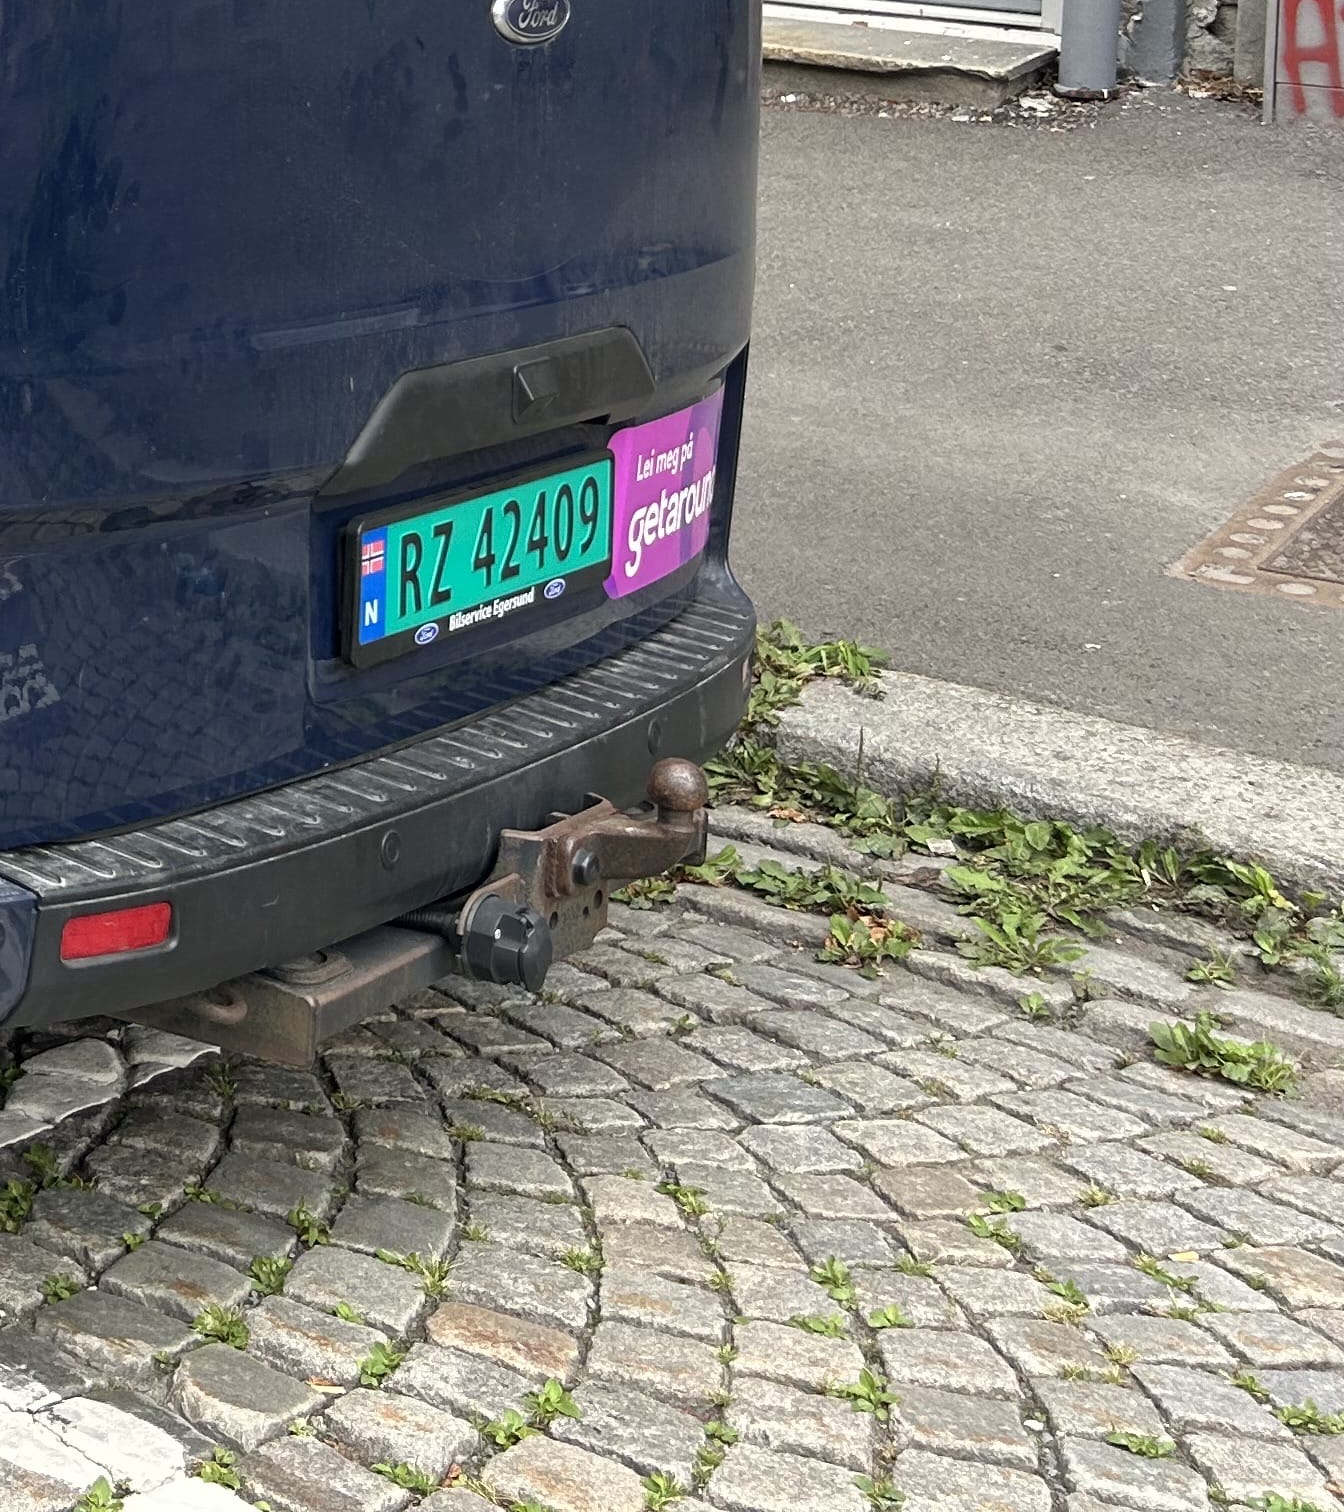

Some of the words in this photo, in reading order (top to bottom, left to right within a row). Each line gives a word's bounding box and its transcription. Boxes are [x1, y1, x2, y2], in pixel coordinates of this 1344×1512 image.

[636, 448, 655, 482] Lei
[655, 446, 680, 475] meg
[679, 431, 694, 472] på
[398, 520, 456, 619] RZ
[471, 475, 601, 589] 42409
[363, 598, 379, 627] N
[448, 603, 493, 632] Bilservice
[492, 586, 536, 618] Egersund
